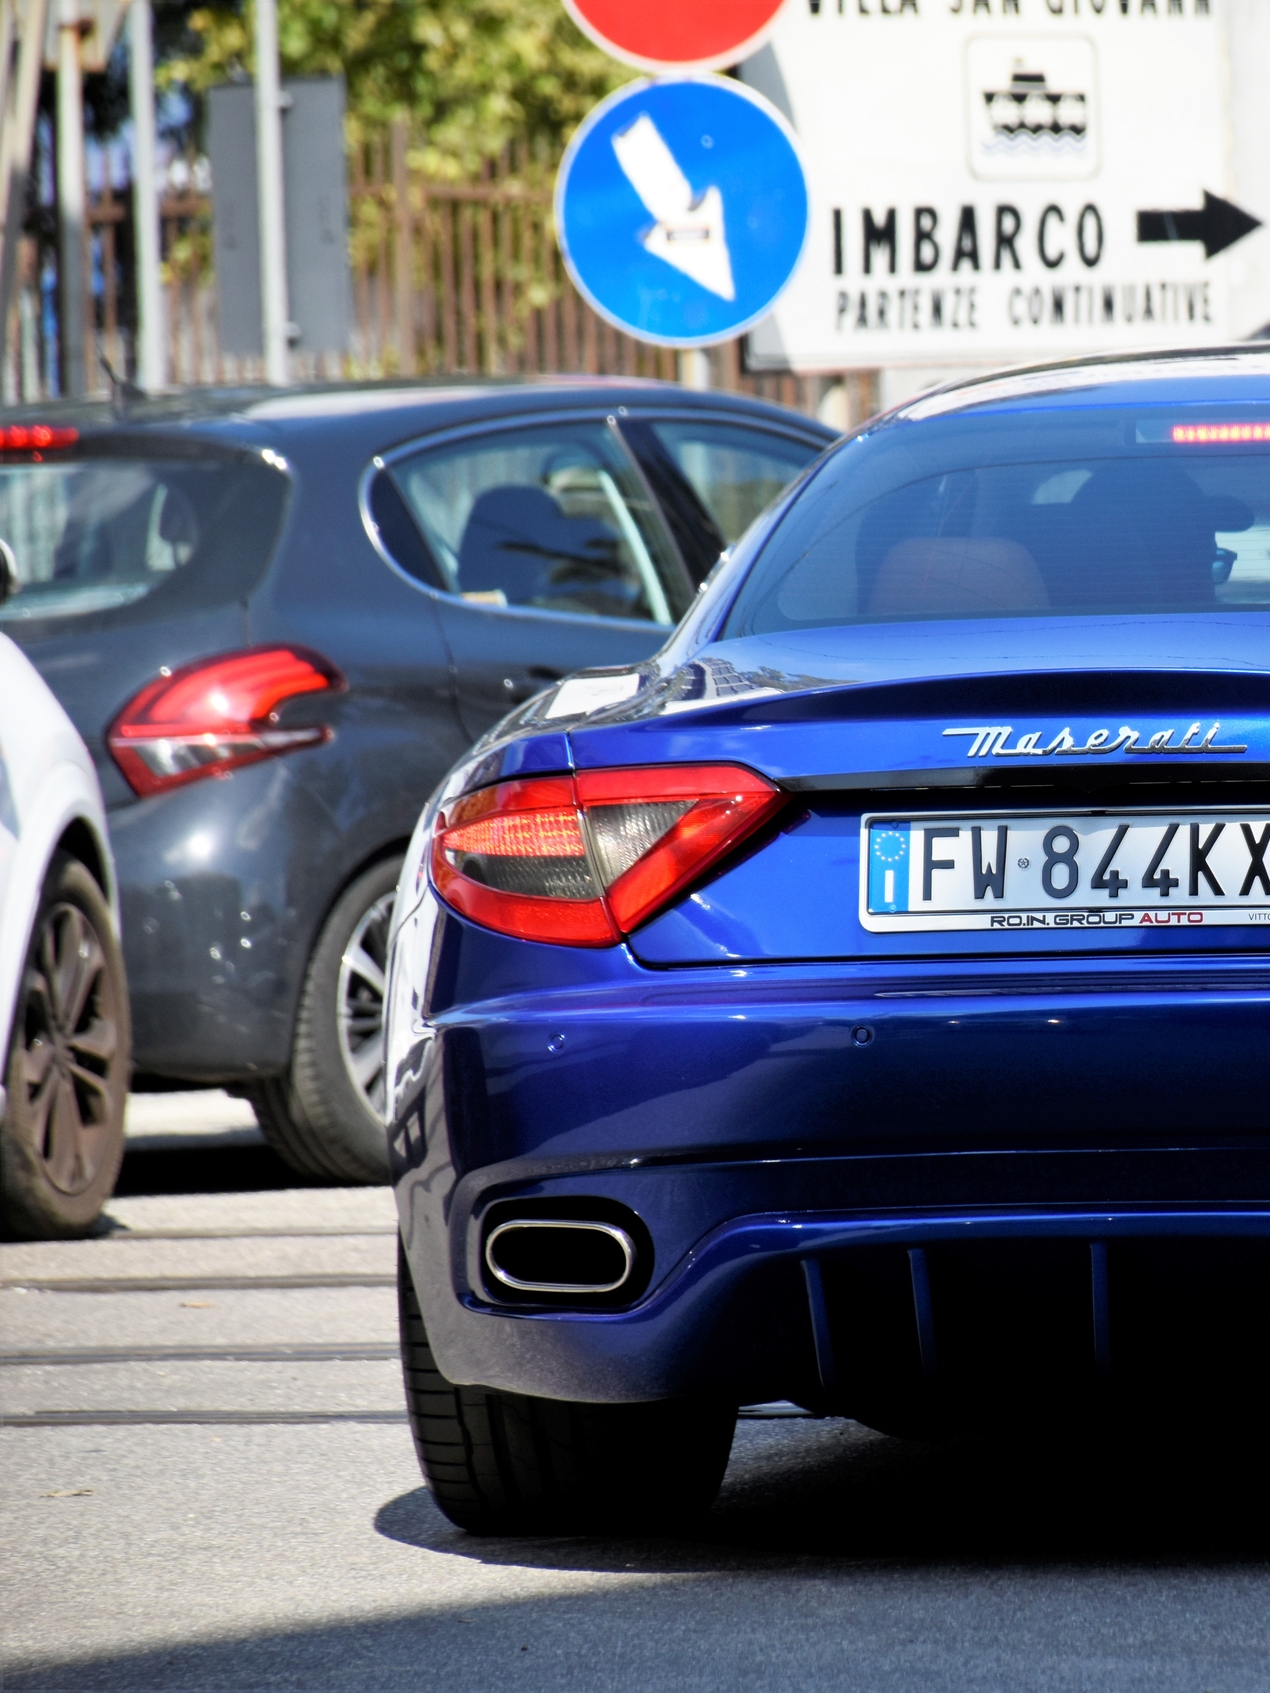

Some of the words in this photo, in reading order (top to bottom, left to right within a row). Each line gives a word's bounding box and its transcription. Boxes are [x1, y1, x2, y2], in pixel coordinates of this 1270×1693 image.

[833, 203, 1104, 275] IMBARCO
[836, 286, 976, 330] PARTENZE
[1009, 277, 1212, 326] CONTINUATIVE
[942, 722, 1247, 757] Maserati
[922, 825, 1008, 901] FW
[990, 914, 1050, 928] RO.IN.
[1054, 912, 1135, 926] GROUP
[1139, 911, 1204, 924] AUTO
